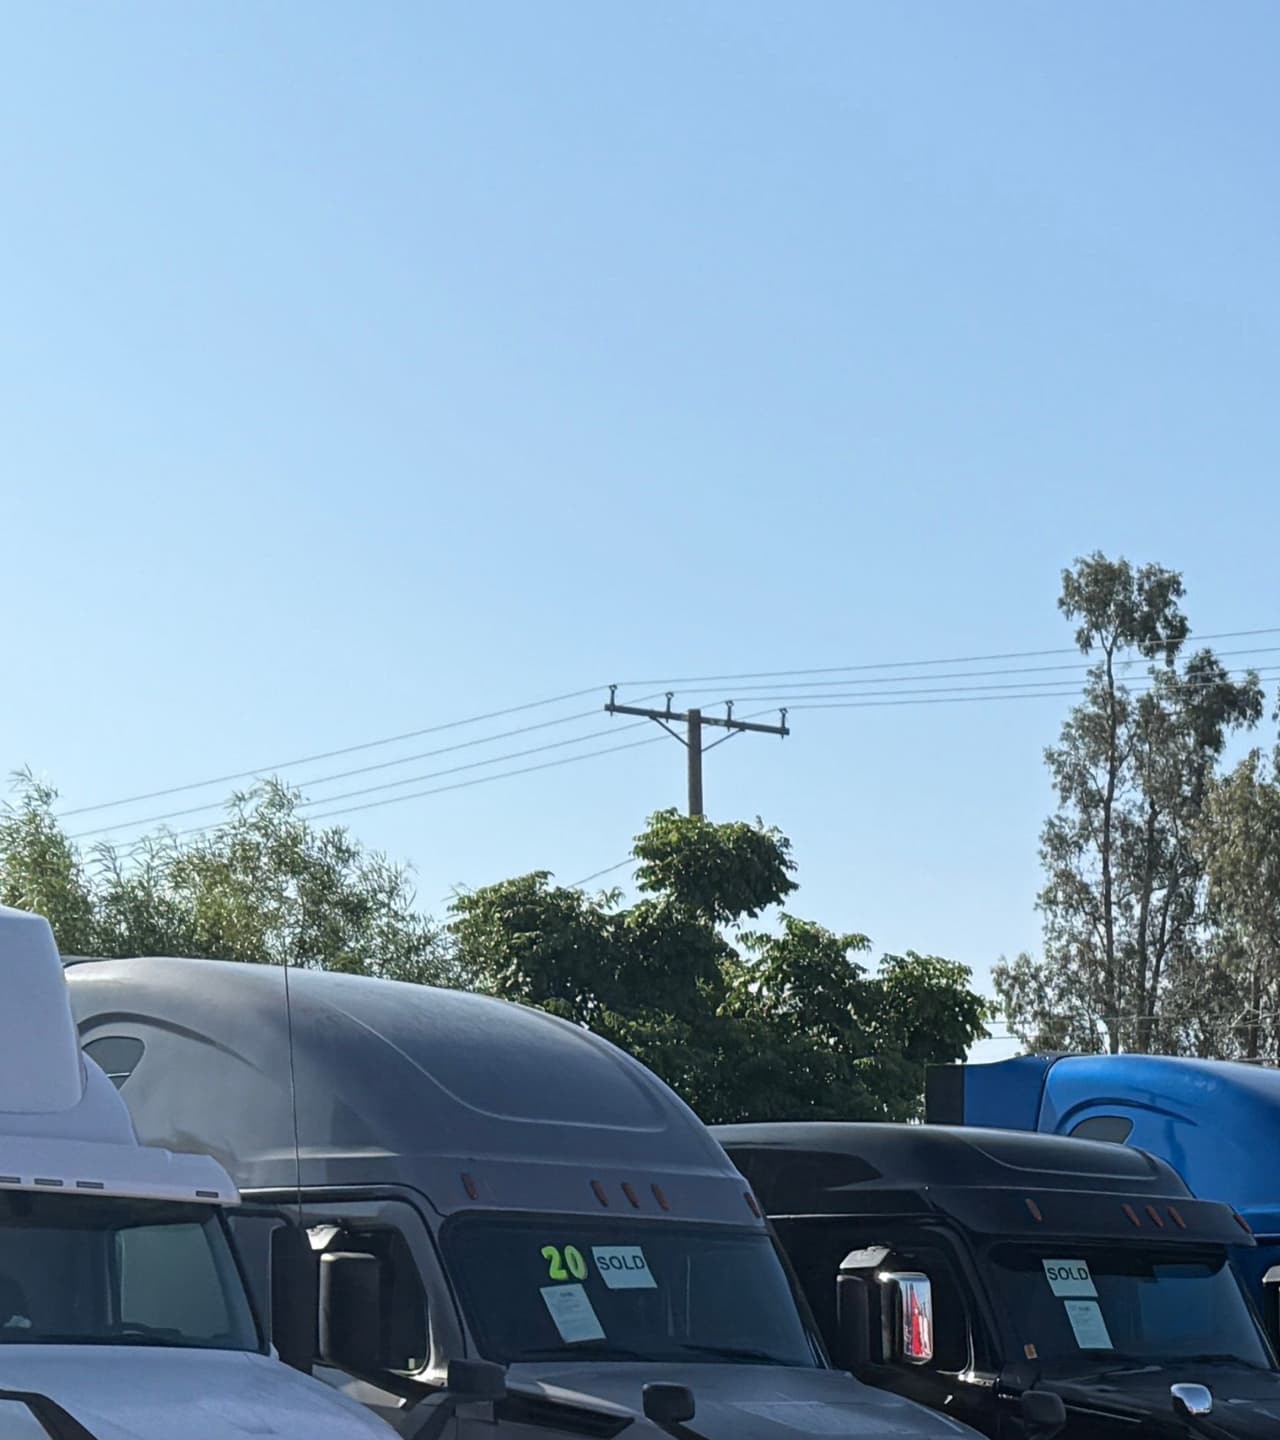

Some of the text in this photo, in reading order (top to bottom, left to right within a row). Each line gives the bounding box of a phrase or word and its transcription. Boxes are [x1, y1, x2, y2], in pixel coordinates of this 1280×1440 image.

[541, 1245, 588, 1280] 20
[597, 1255, 645, 1271] SOLD
[1047, 1267, 1088, 1281] SOLD
